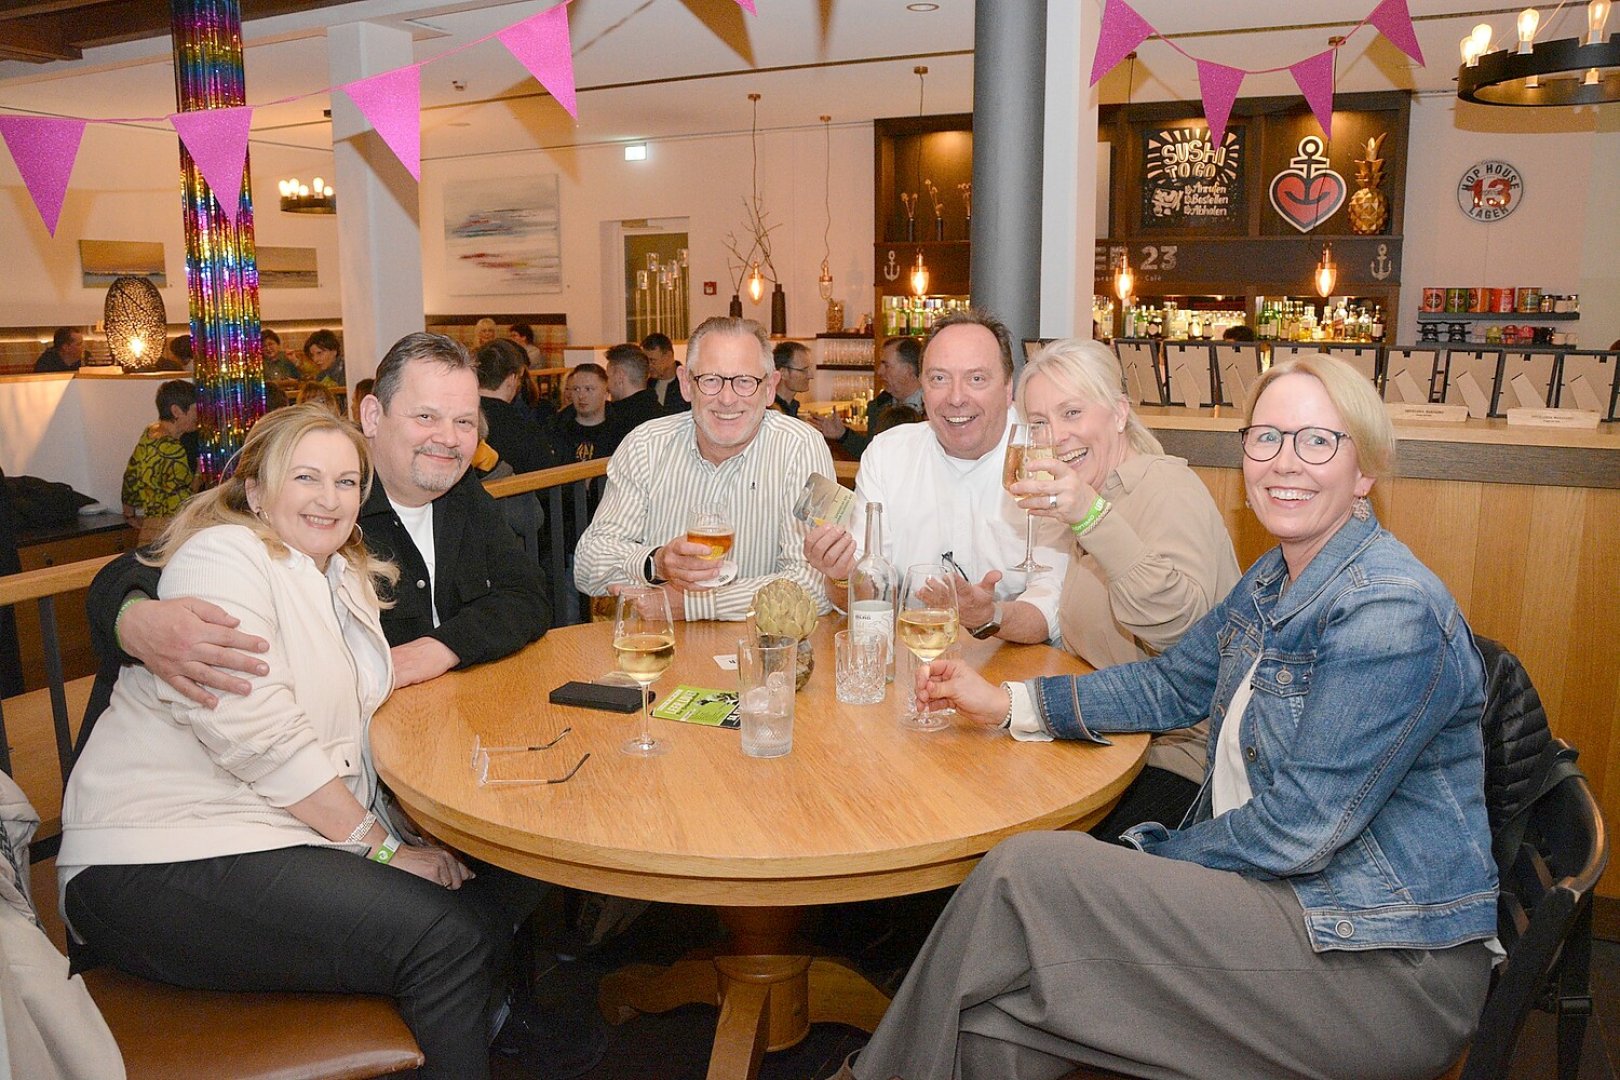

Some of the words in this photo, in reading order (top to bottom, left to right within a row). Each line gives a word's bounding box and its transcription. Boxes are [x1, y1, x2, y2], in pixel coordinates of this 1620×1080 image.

[1161, 140, 1226, 167] SUSHI
[1164, 162, 1190, 182] TO
[1192, 162, 1216, 179] GO
[1461, 168, 1480, 191] HOP
[1486, 164, 1520, 190] HOUSE
[1191, 182, 1227, 195] Anrufen
[1472, 178, 1511, 208] 13
[1191, 194, 1229, 204] Bestellen
[1190, 205, 1228, 215] Abholen
[1469, 207, 1509, 219] LAGER
[1140, 245, 1178, 271] 23
